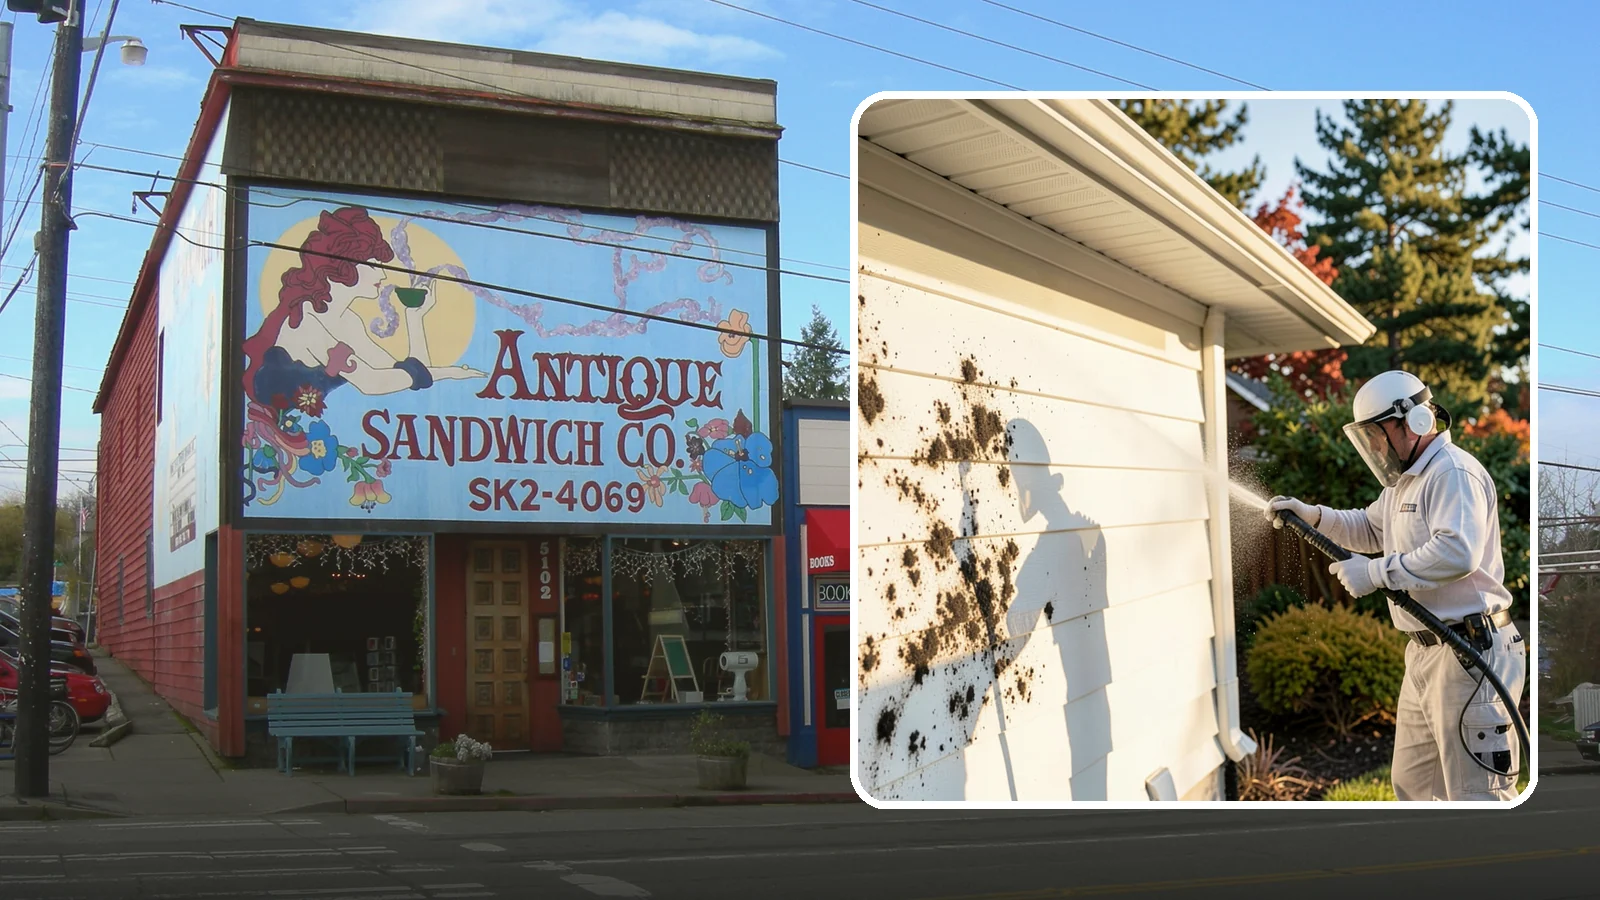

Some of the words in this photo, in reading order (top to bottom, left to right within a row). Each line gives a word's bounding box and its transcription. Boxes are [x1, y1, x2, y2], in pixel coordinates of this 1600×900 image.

[476, 329, 724, 420] ANTIQUE
[361, 409, 604, 467] SANDWICH
[617, 421, 685, 469] CO.
[468, 477, 645, 513] SK2-4069
[539, 541, 551, 600] 5102
[809, 555, 835, 569] BOOKS
